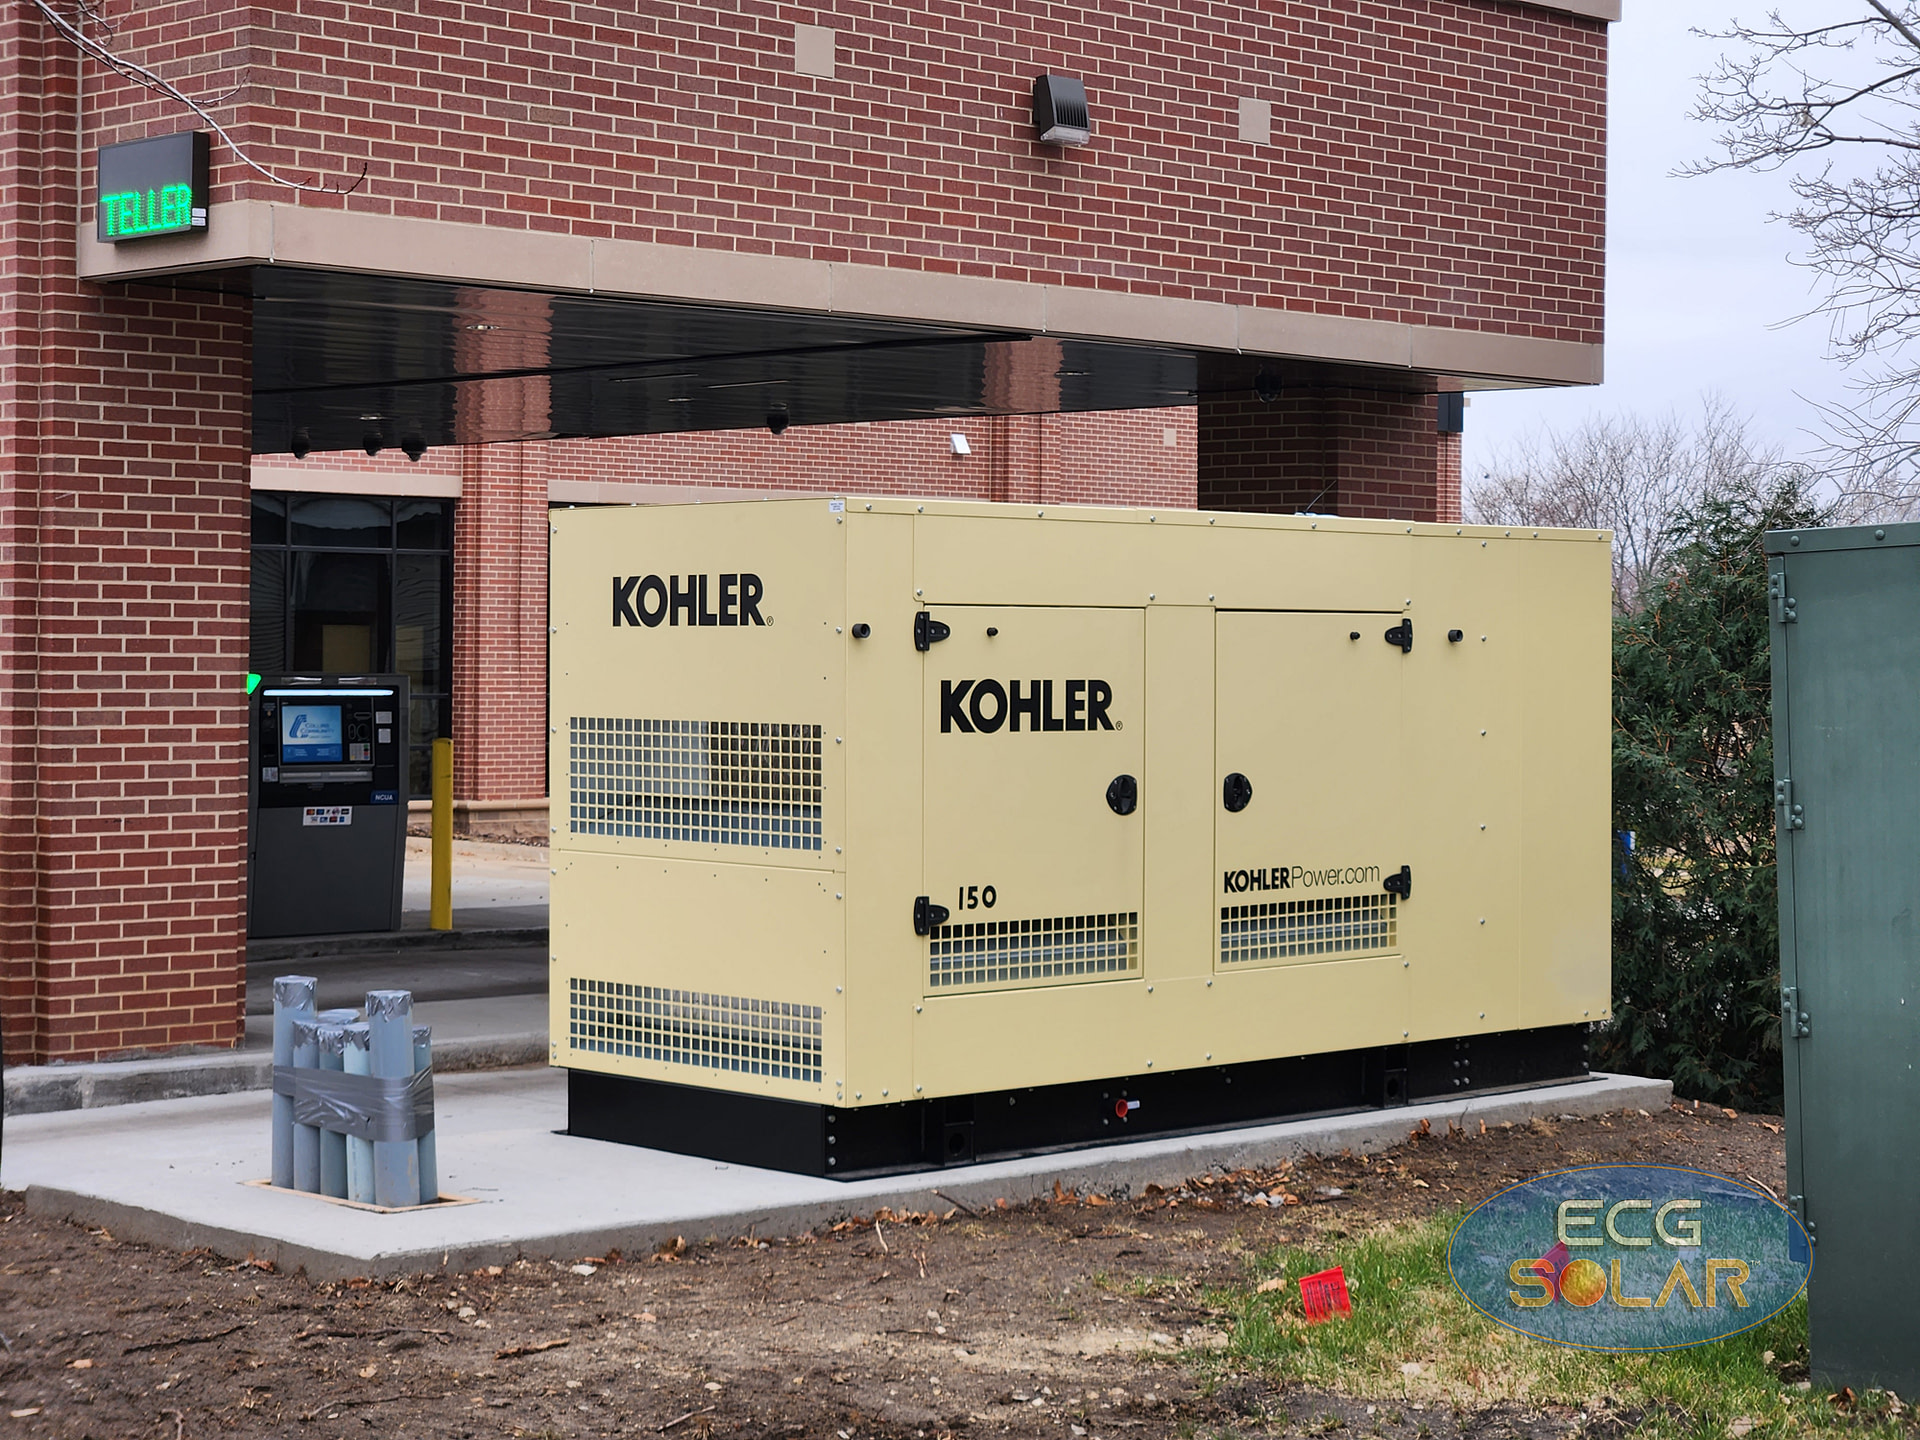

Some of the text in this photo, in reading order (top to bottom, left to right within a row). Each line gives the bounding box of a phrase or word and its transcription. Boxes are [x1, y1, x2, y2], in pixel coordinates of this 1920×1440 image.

[101, 183, 192, 236] TELLER
[612, 573, 766, 628] KOHLER
[940, 678, 1115, 734] KOHLER
[958, 884, 997, 911] 150
[1223, 865, 1380, 894] KOHLERPower.com
